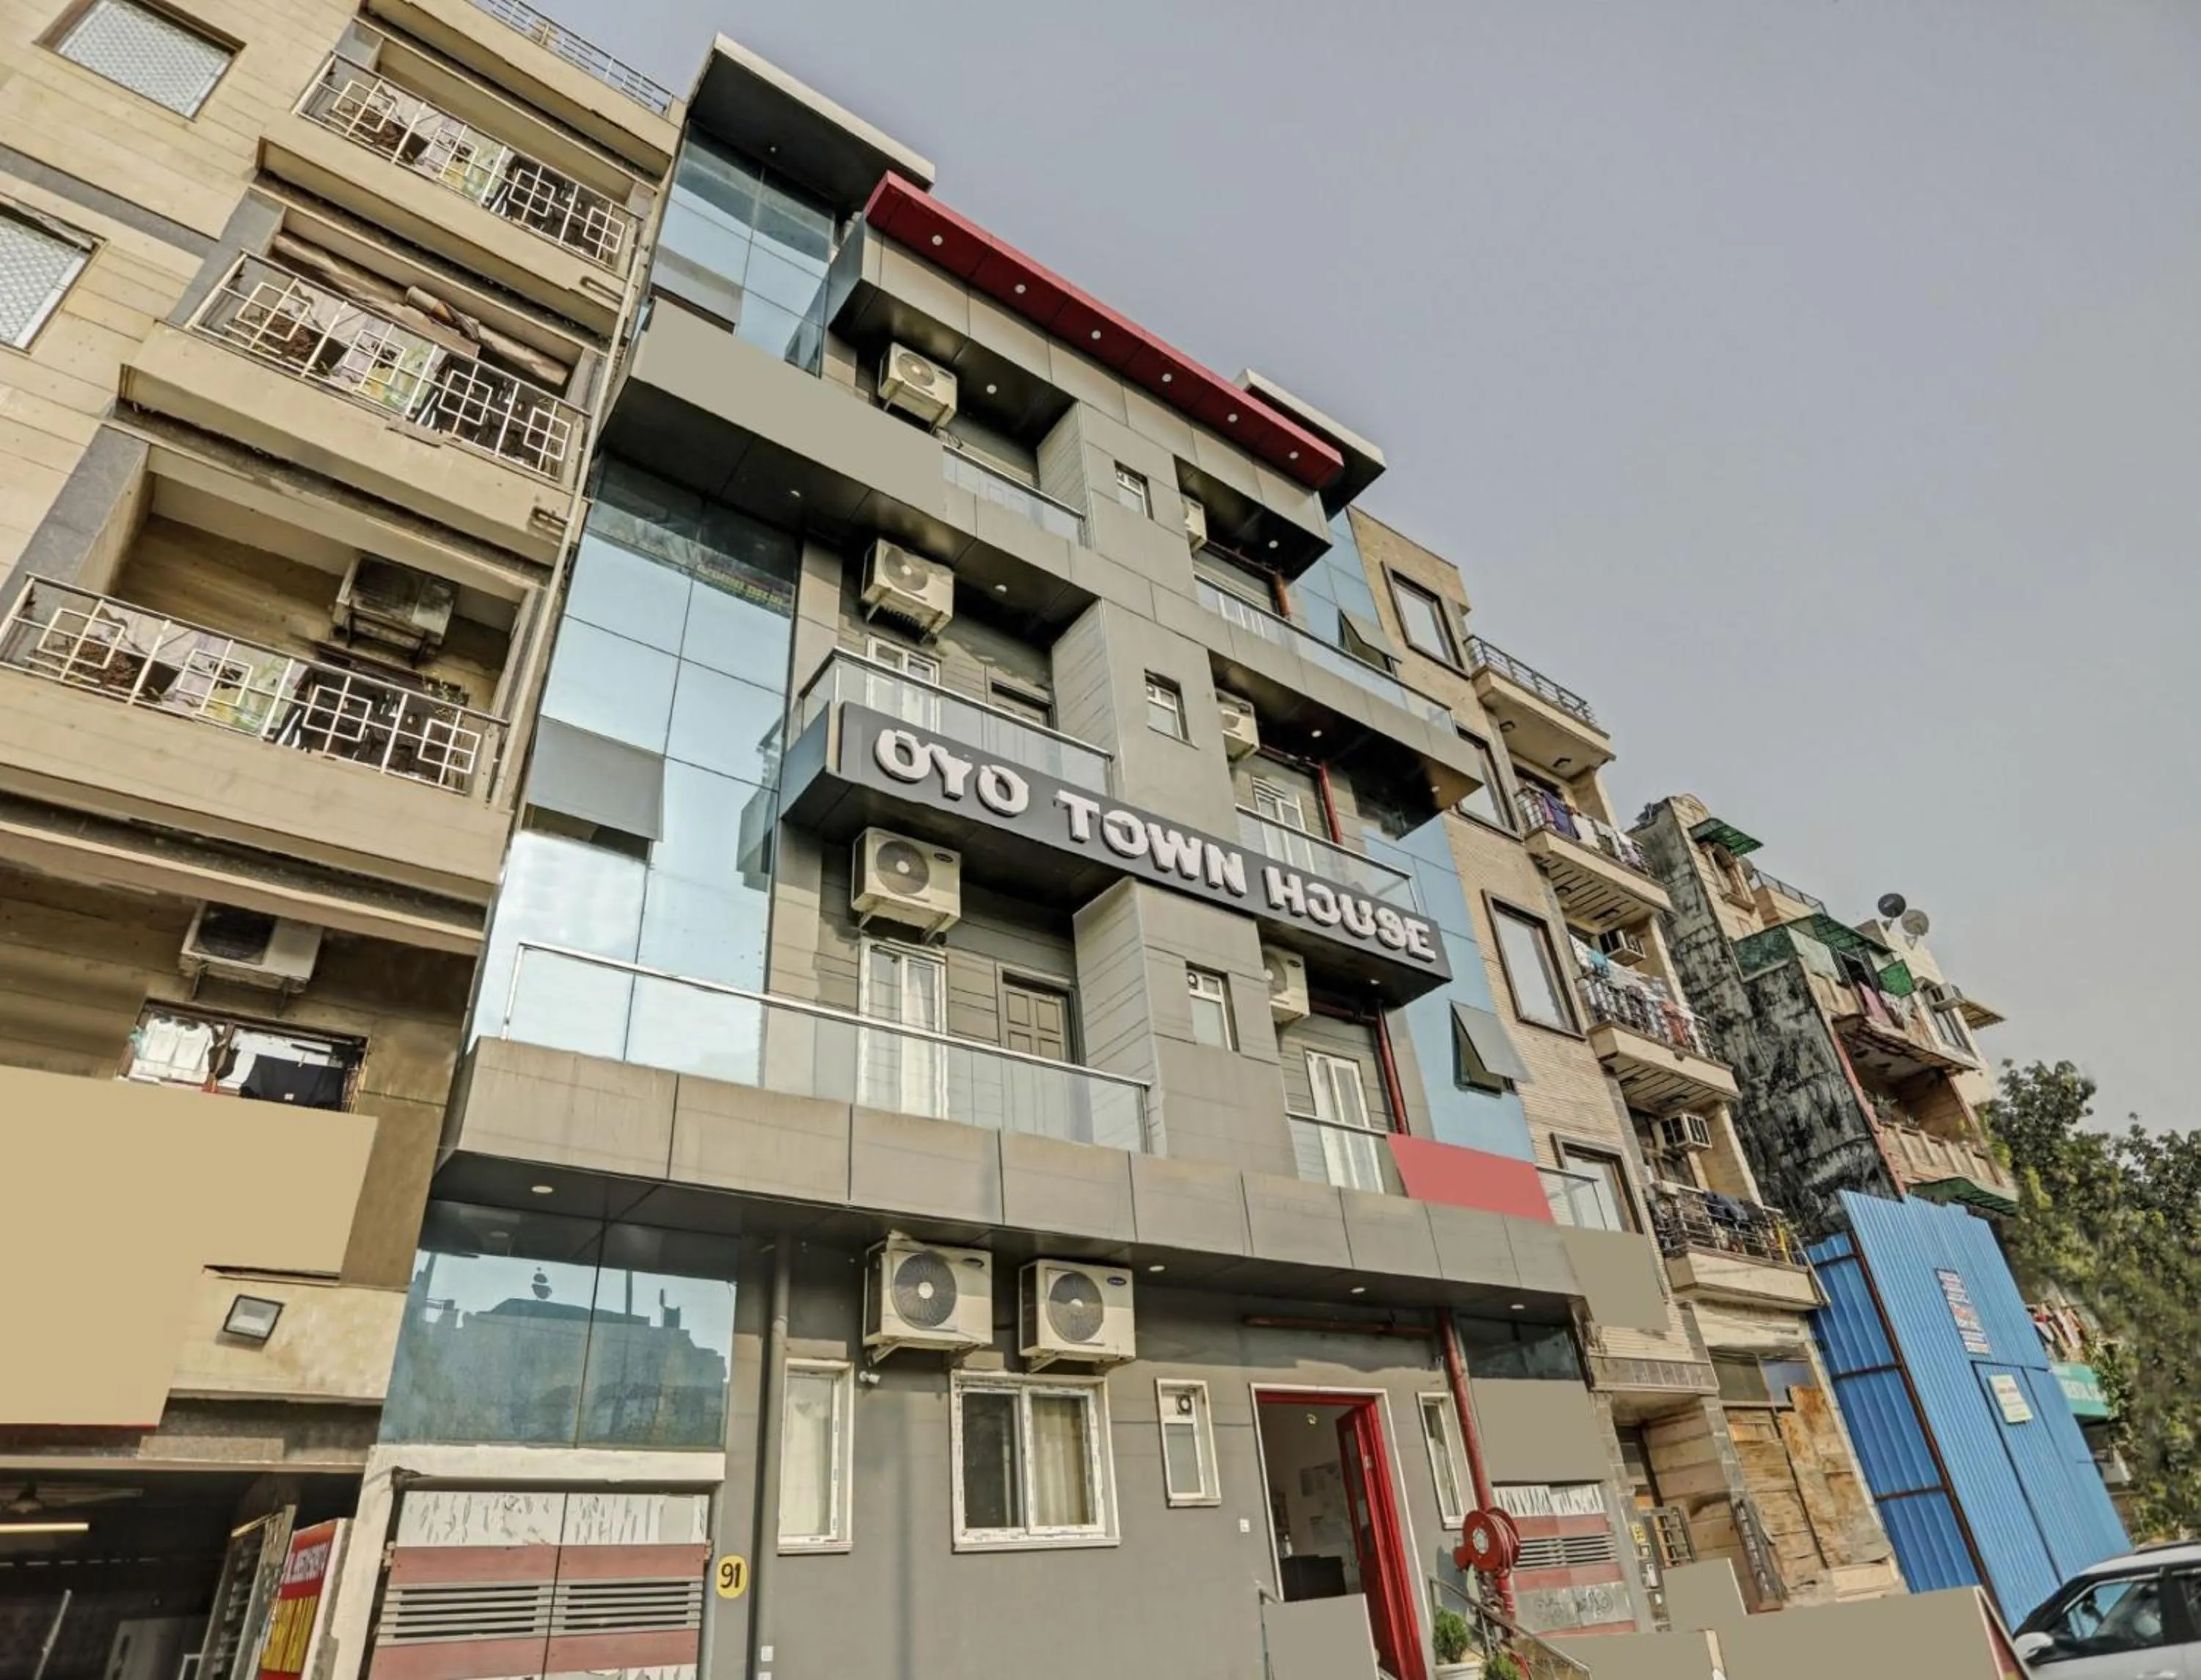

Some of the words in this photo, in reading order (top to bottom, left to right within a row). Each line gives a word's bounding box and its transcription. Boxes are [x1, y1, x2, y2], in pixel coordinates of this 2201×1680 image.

[875, 728, 1029, 815] OYO
[1055, 789, 1246, 896] TOWN
[1263, 866, 1437, 962] HOUSE
[720, 1563, 741, 1588] 91
